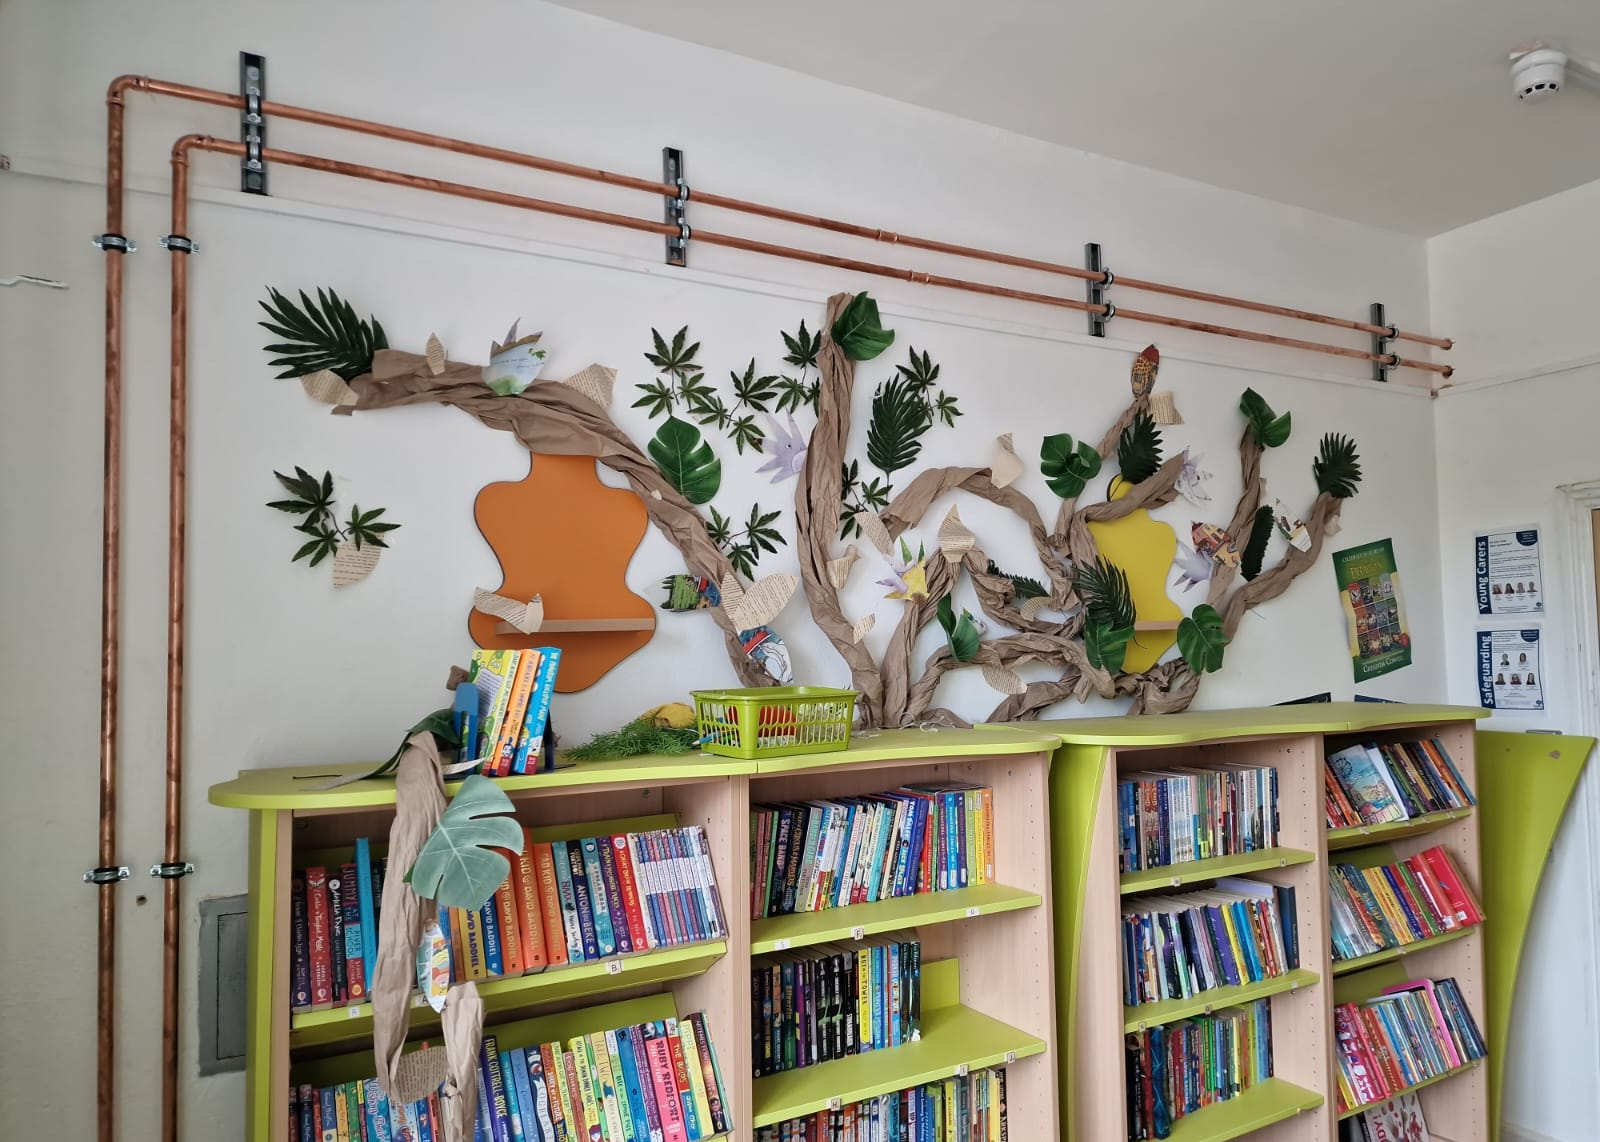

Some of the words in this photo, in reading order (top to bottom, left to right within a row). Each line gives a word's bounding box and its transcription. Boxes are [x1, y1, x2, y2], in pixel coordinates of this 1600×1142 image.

[1477, 541, 1487, 575] Carers
[1480, 577, 1489, 610] Young
[1480, 636, 1493, 705] Safeguarding
[778, 818, 789, 843] SPACE
[519, 857, 531, 874] KID
[775, 843, 786, 865] BAND
[341, 868, 357, 902] JUMMY
[541, 868, 552, 884] KID
[484, 901, 492, 923] DAVID
[503, 901, 512, 924] DAVID
[524, 885, 534, 909] DAVID
[1362, 890, 1374, 908] BAD
[576, 884, 588, 912] ANTON
[583, 921, 593, 943] BEKE
[486, 925, 495, 956] BADDIEL
[505, 925, 516, 959] BADDIEL
[527, 912, 539, 950] BADDIEL
[466, 931, 479, 967] BADDIEL
[483, 1037, 497, 1061] FRANK
[649, 1044, 657, 1058] FEEL
[654, 1067, 662, 1083] FEAR
[654, 1040, 669, 1071] RUBY
[673, 1043, 681, 1058] THE
[546, 1071, 555, 1088] DIARY
[676, 1060, 686, 1083] BOLDS
[486, 1060, 508, 1118] COTTRELL-BOYCE
[661, 1071, 679, 1122] REDFORT
